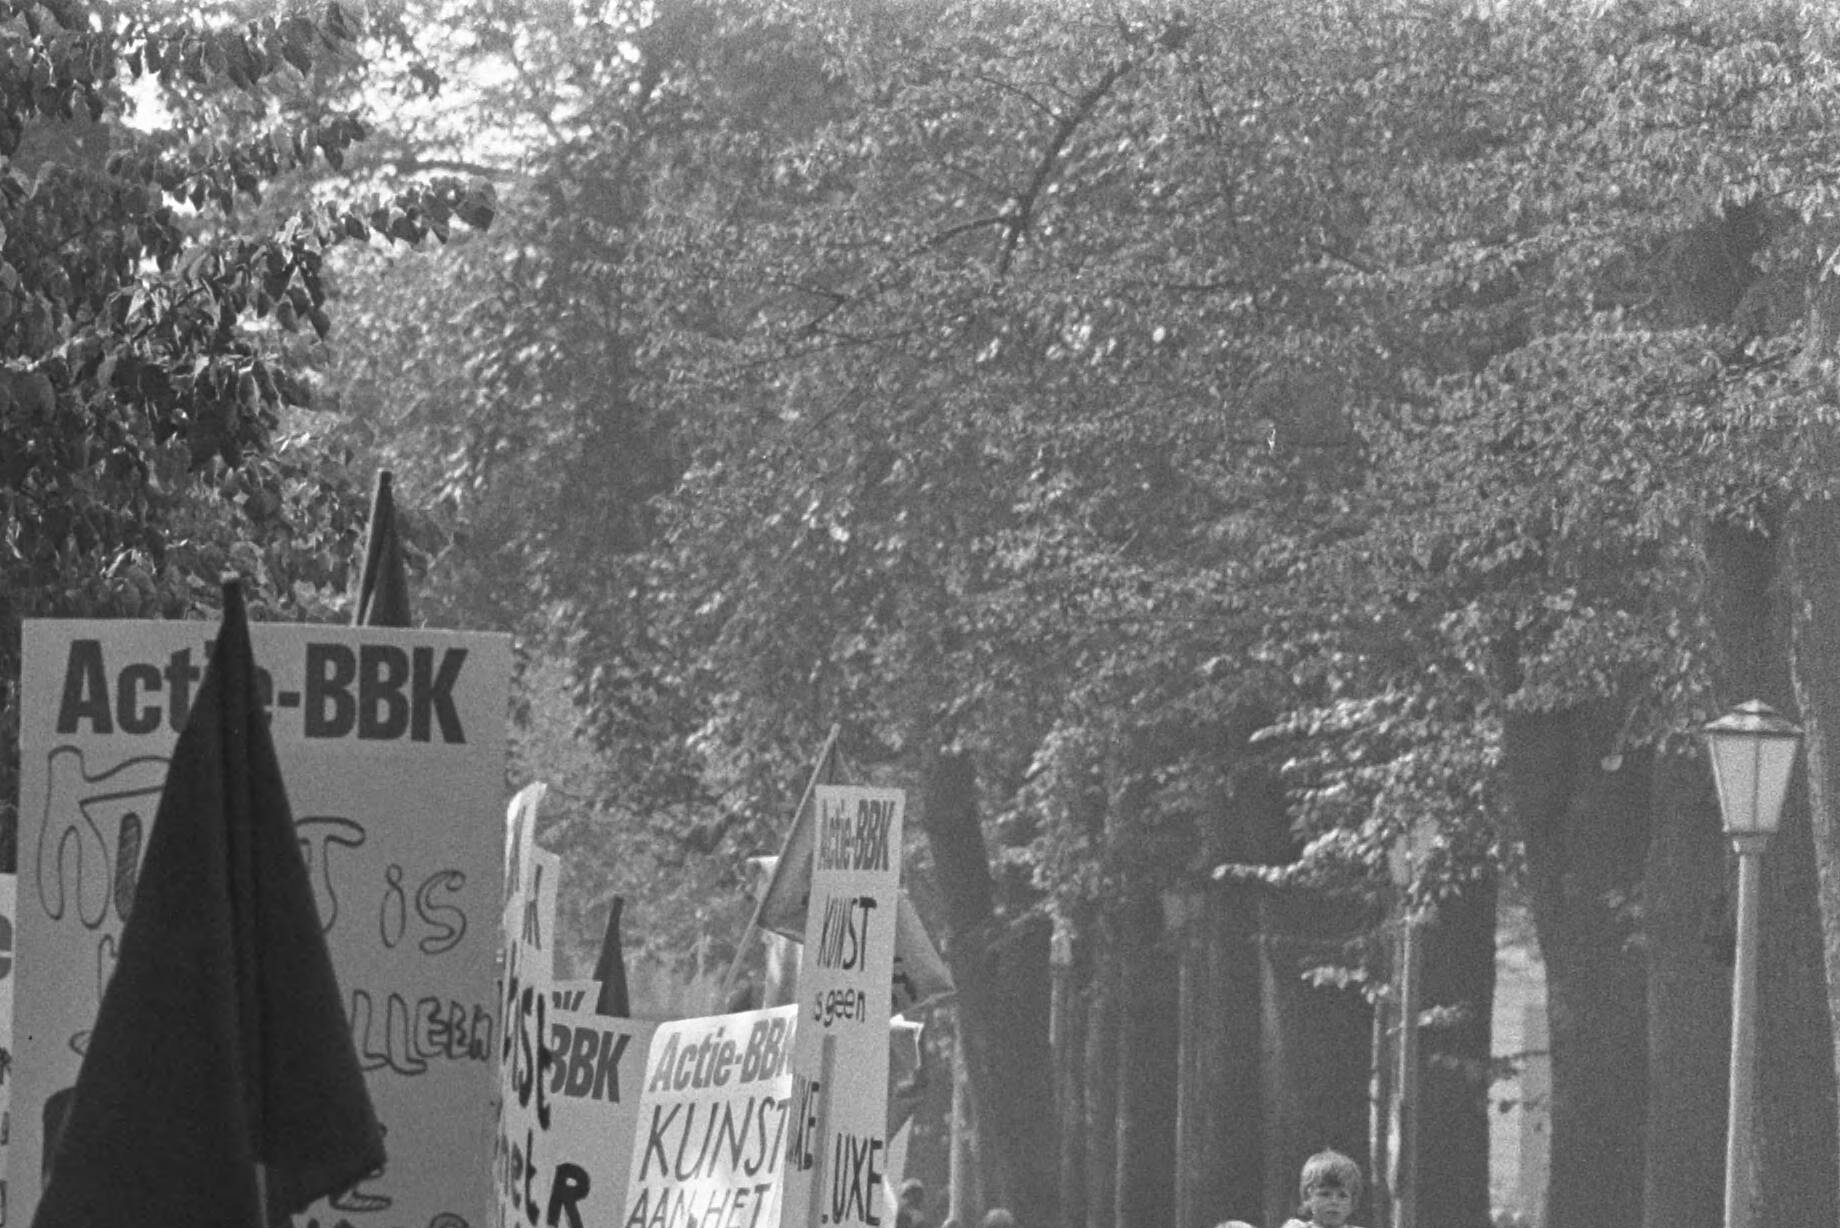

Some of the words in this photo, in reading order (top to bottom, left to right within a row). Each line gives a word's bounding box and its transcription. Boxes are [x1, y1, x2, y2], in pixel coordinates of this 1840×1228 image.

[56, 639, 469, 744] Act-BBK
[819, 893, 877, 972] KUNST
[823, 987, 866, 1028] geen
[639, 1096, 793, 1182] KUNST
[821, 1131, 883, 1226] UXE
